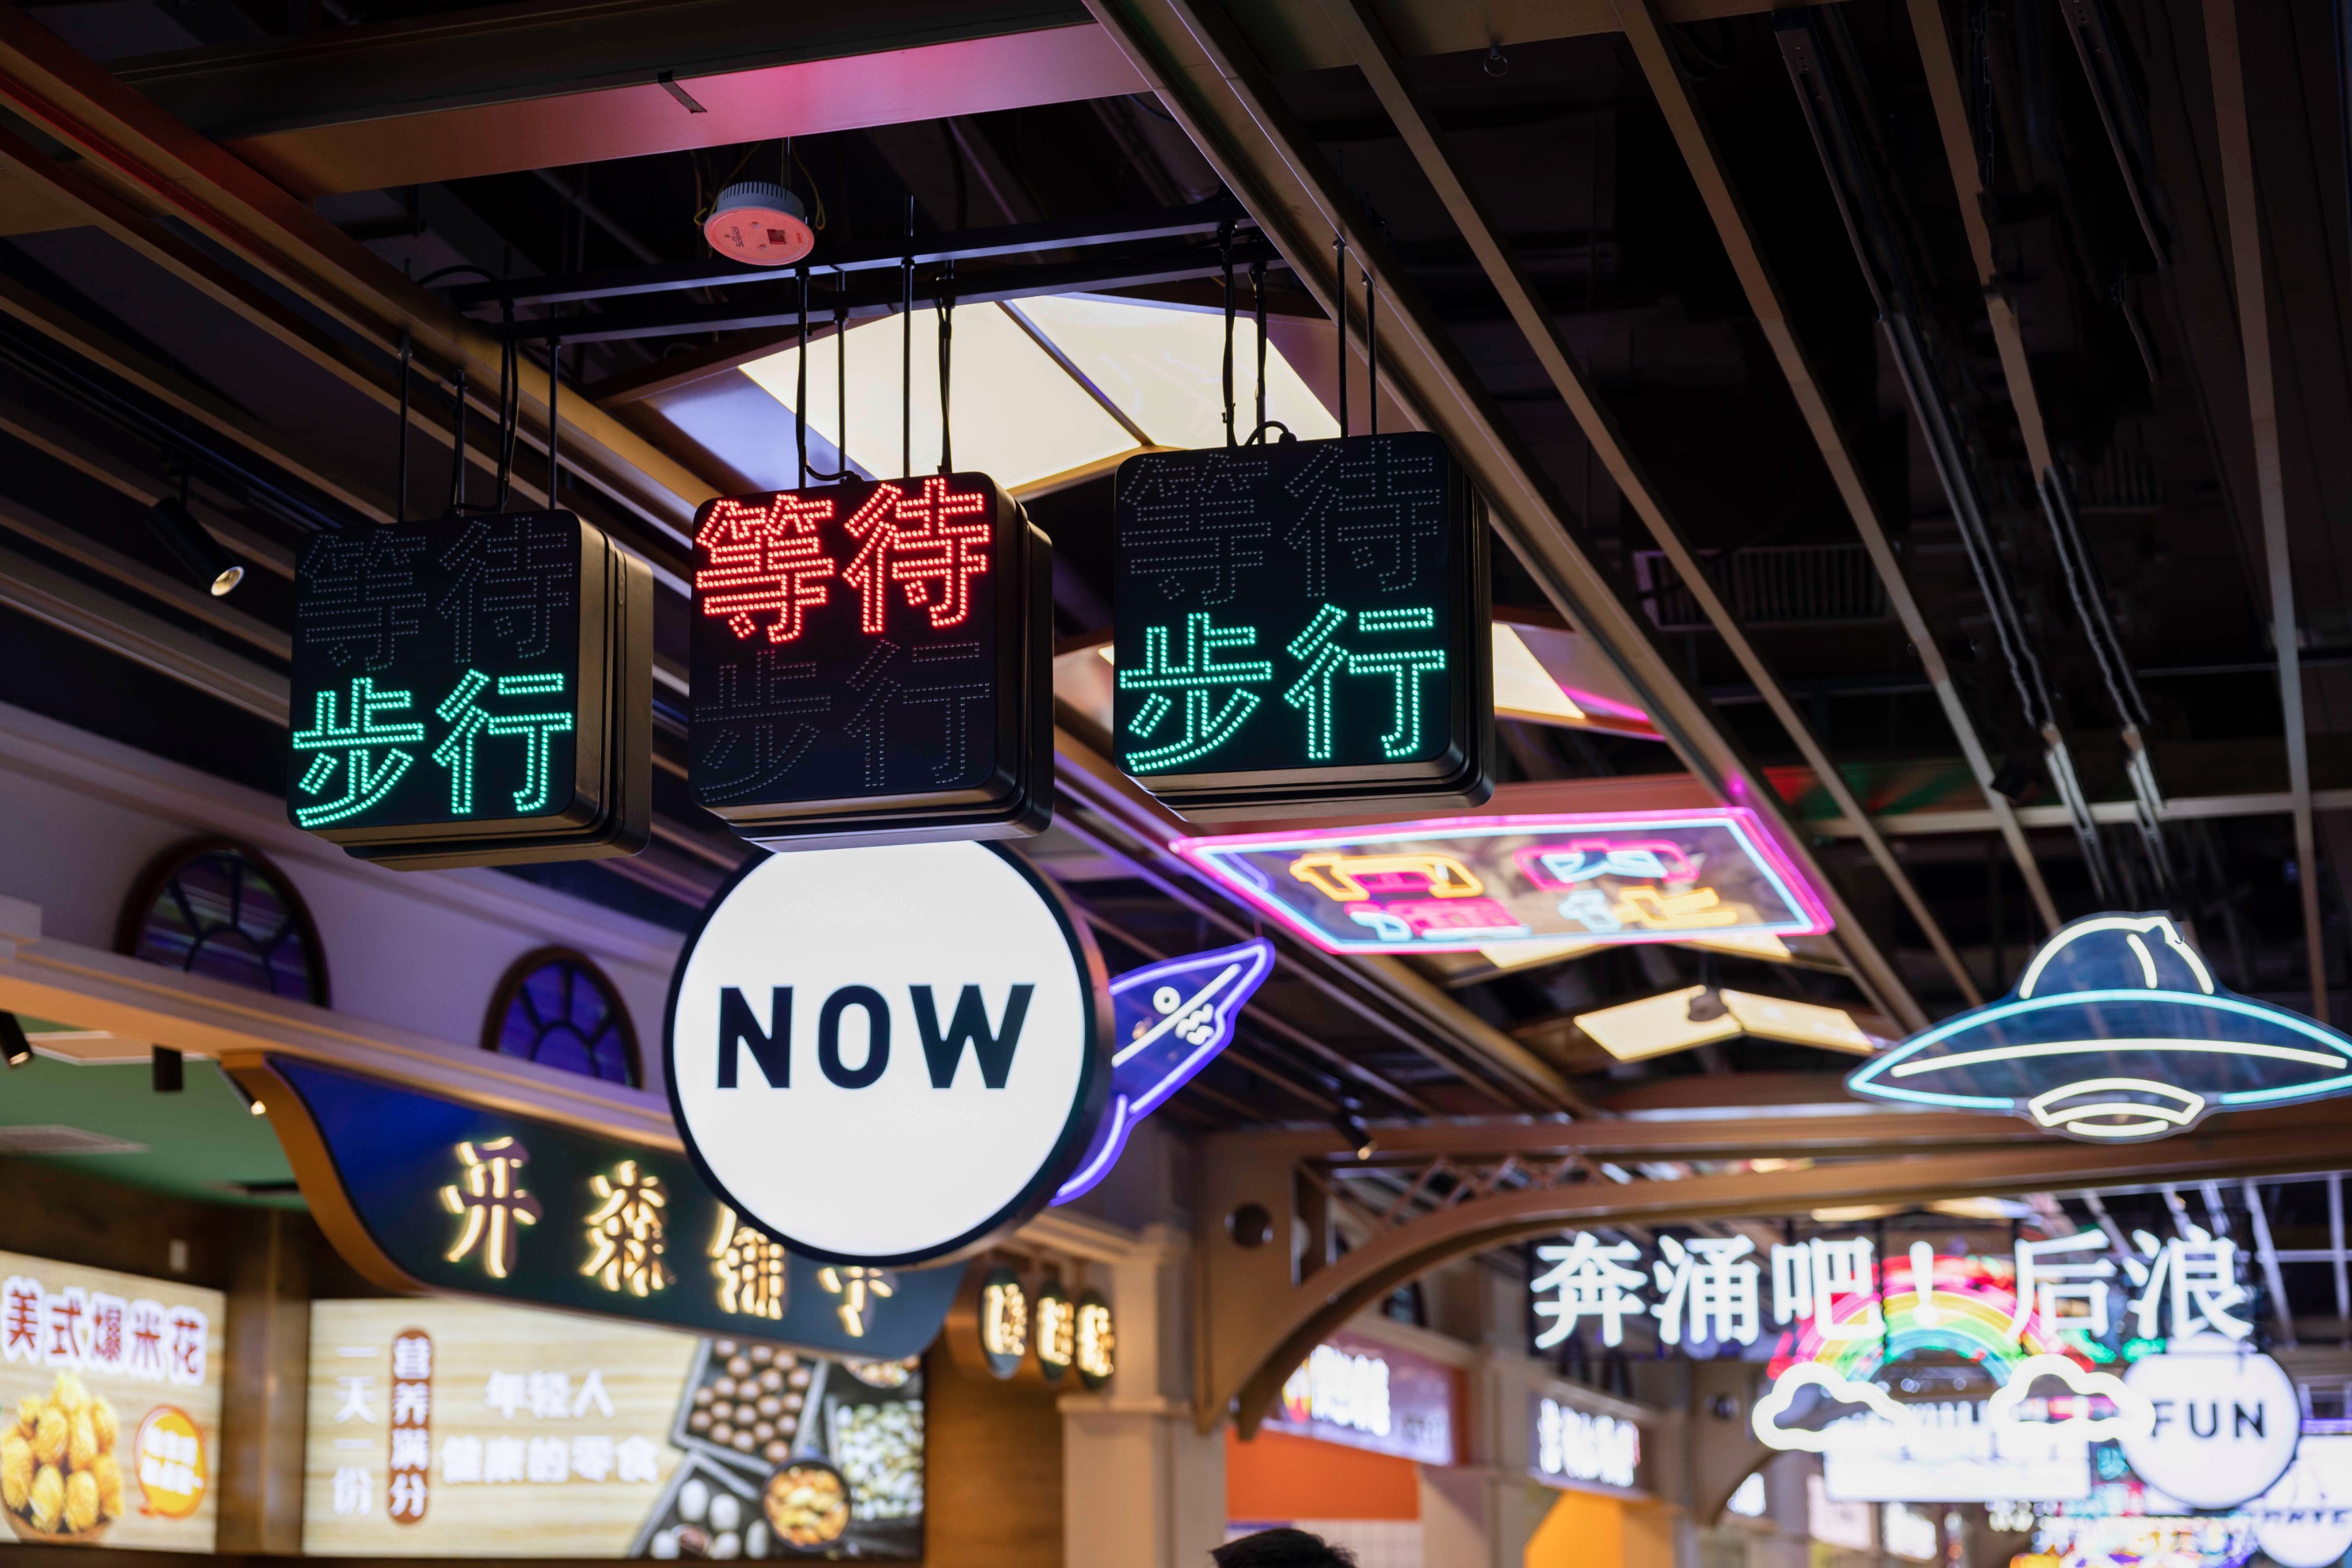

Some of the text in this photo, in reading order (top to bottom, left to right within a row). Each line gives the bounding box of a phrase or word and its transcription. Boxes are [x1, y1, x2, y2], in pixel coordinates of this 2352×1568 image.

[299, 516, 573, 672] 等待
[695, 478, 989, 642] 等待
[1120, 440, 1441, 605] 等待
[292, 668, 573, 828] 步行
[695, 637, 990, 802] 步行
[1119, 603, 1446, 773] 步行
[717, 984, 1035, 1090] NOW
[5, 1283, 203, 1380] 美式爆米花
[2149, 1400, 2267, 1439] FUN
